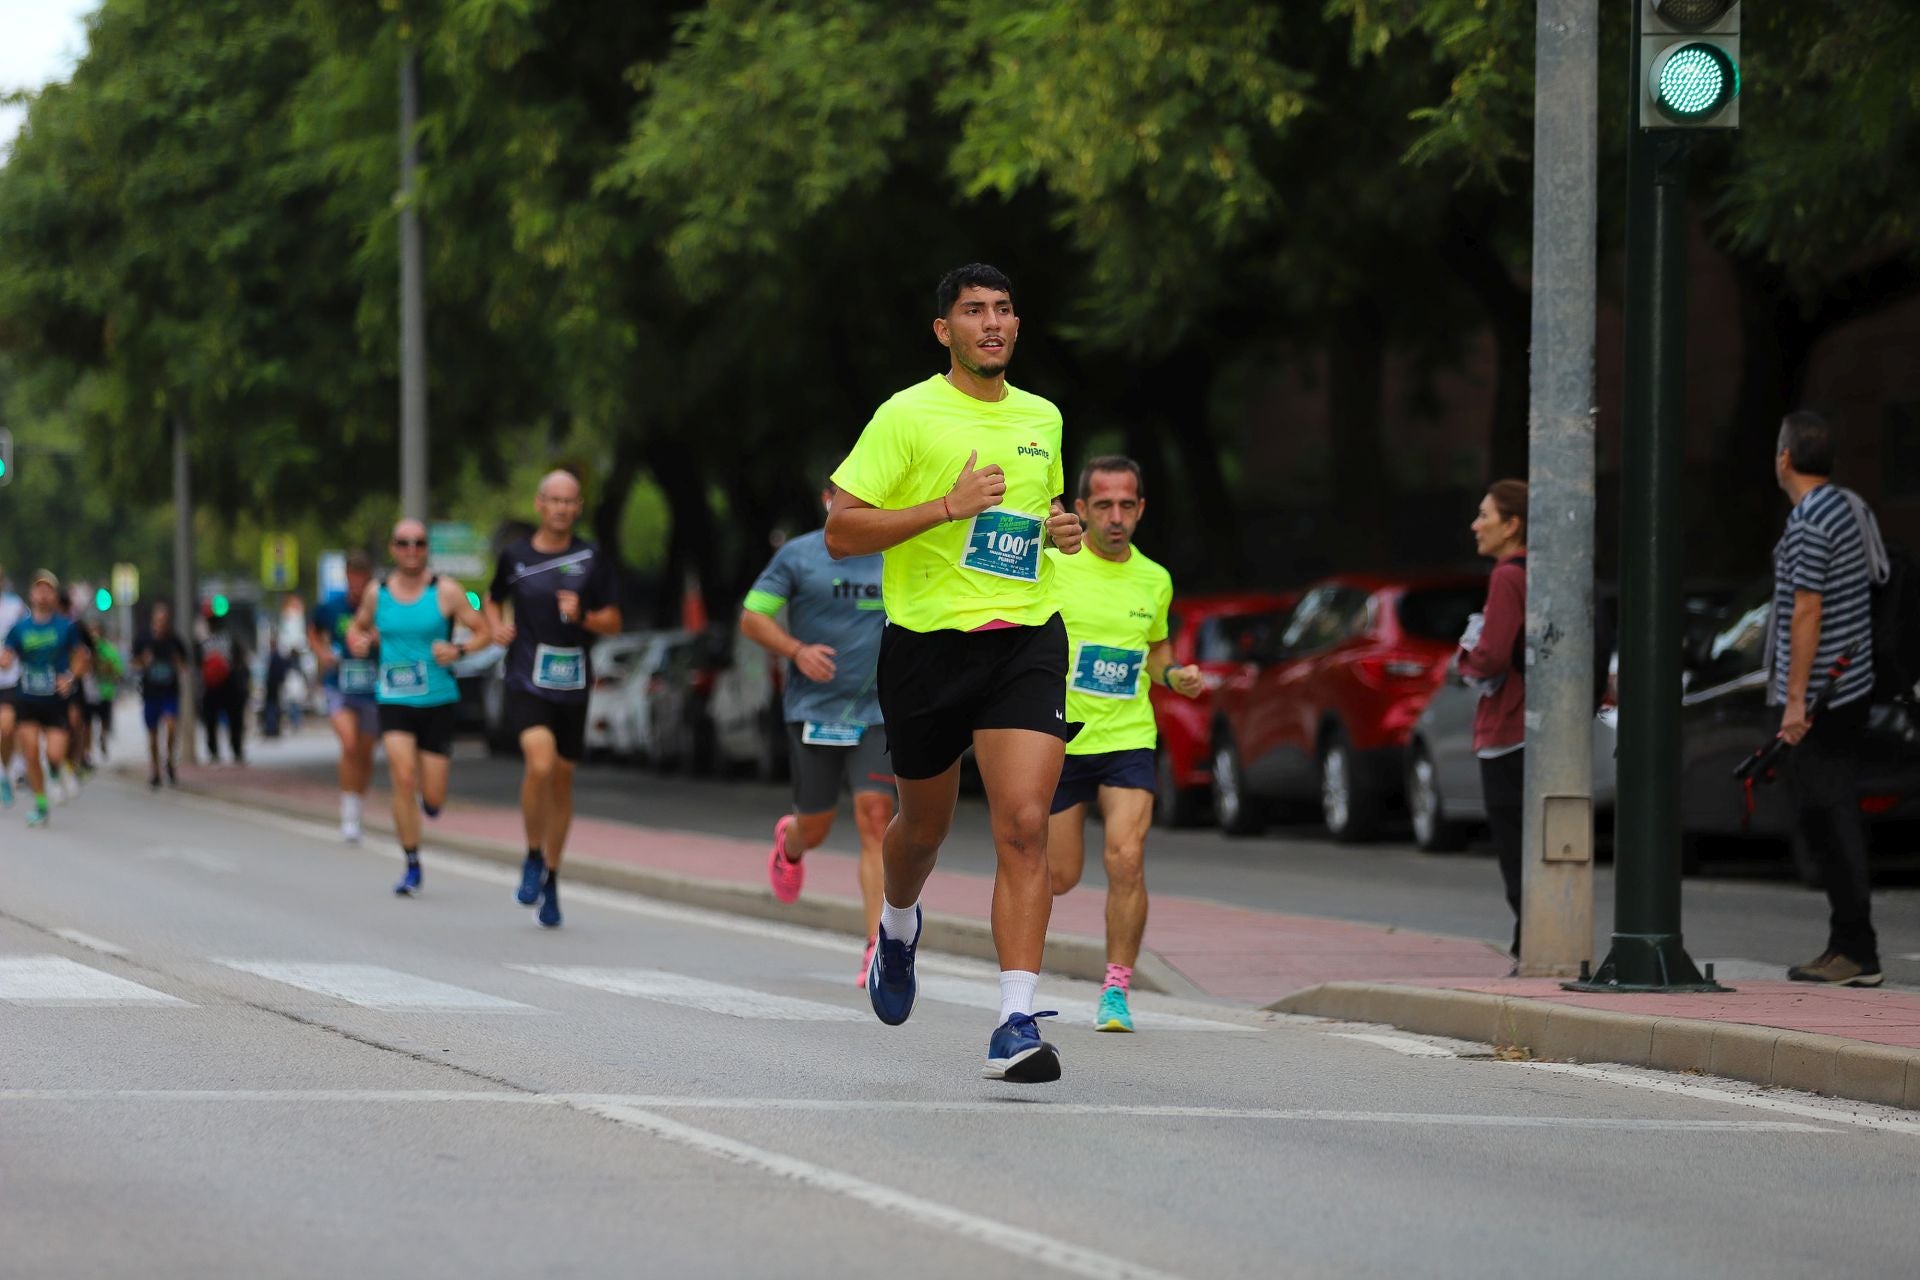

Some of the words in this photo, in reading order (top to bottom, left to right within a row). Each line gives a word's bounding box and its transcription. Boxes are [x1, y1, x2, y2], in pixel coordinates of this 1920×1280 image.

[1017, 444, 1049, 459] pujante
[986, 530, 1031, 557] 1001
[1092, 658, 1129, 680] 988
